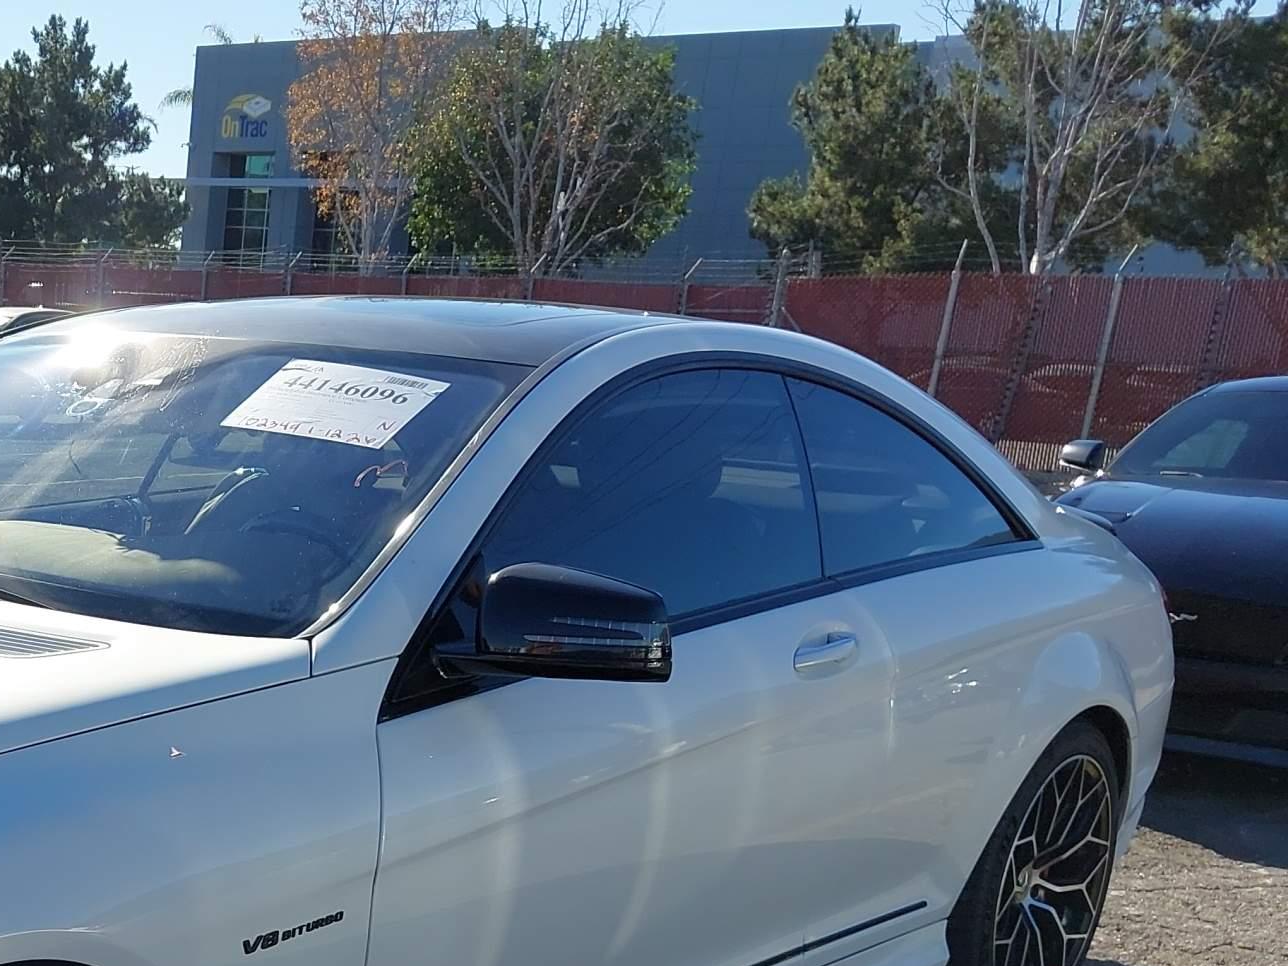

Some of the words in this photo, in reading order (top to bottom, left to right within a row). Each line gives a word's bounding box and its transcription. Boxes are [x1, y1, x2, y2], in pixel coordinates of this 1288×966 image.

[221, 114, 268, 138] OnTrac
[283, 376, 415, 405] 44146096
[242, 930, 280, 955] V8
[281, 910, 344, 941] BITURBO
